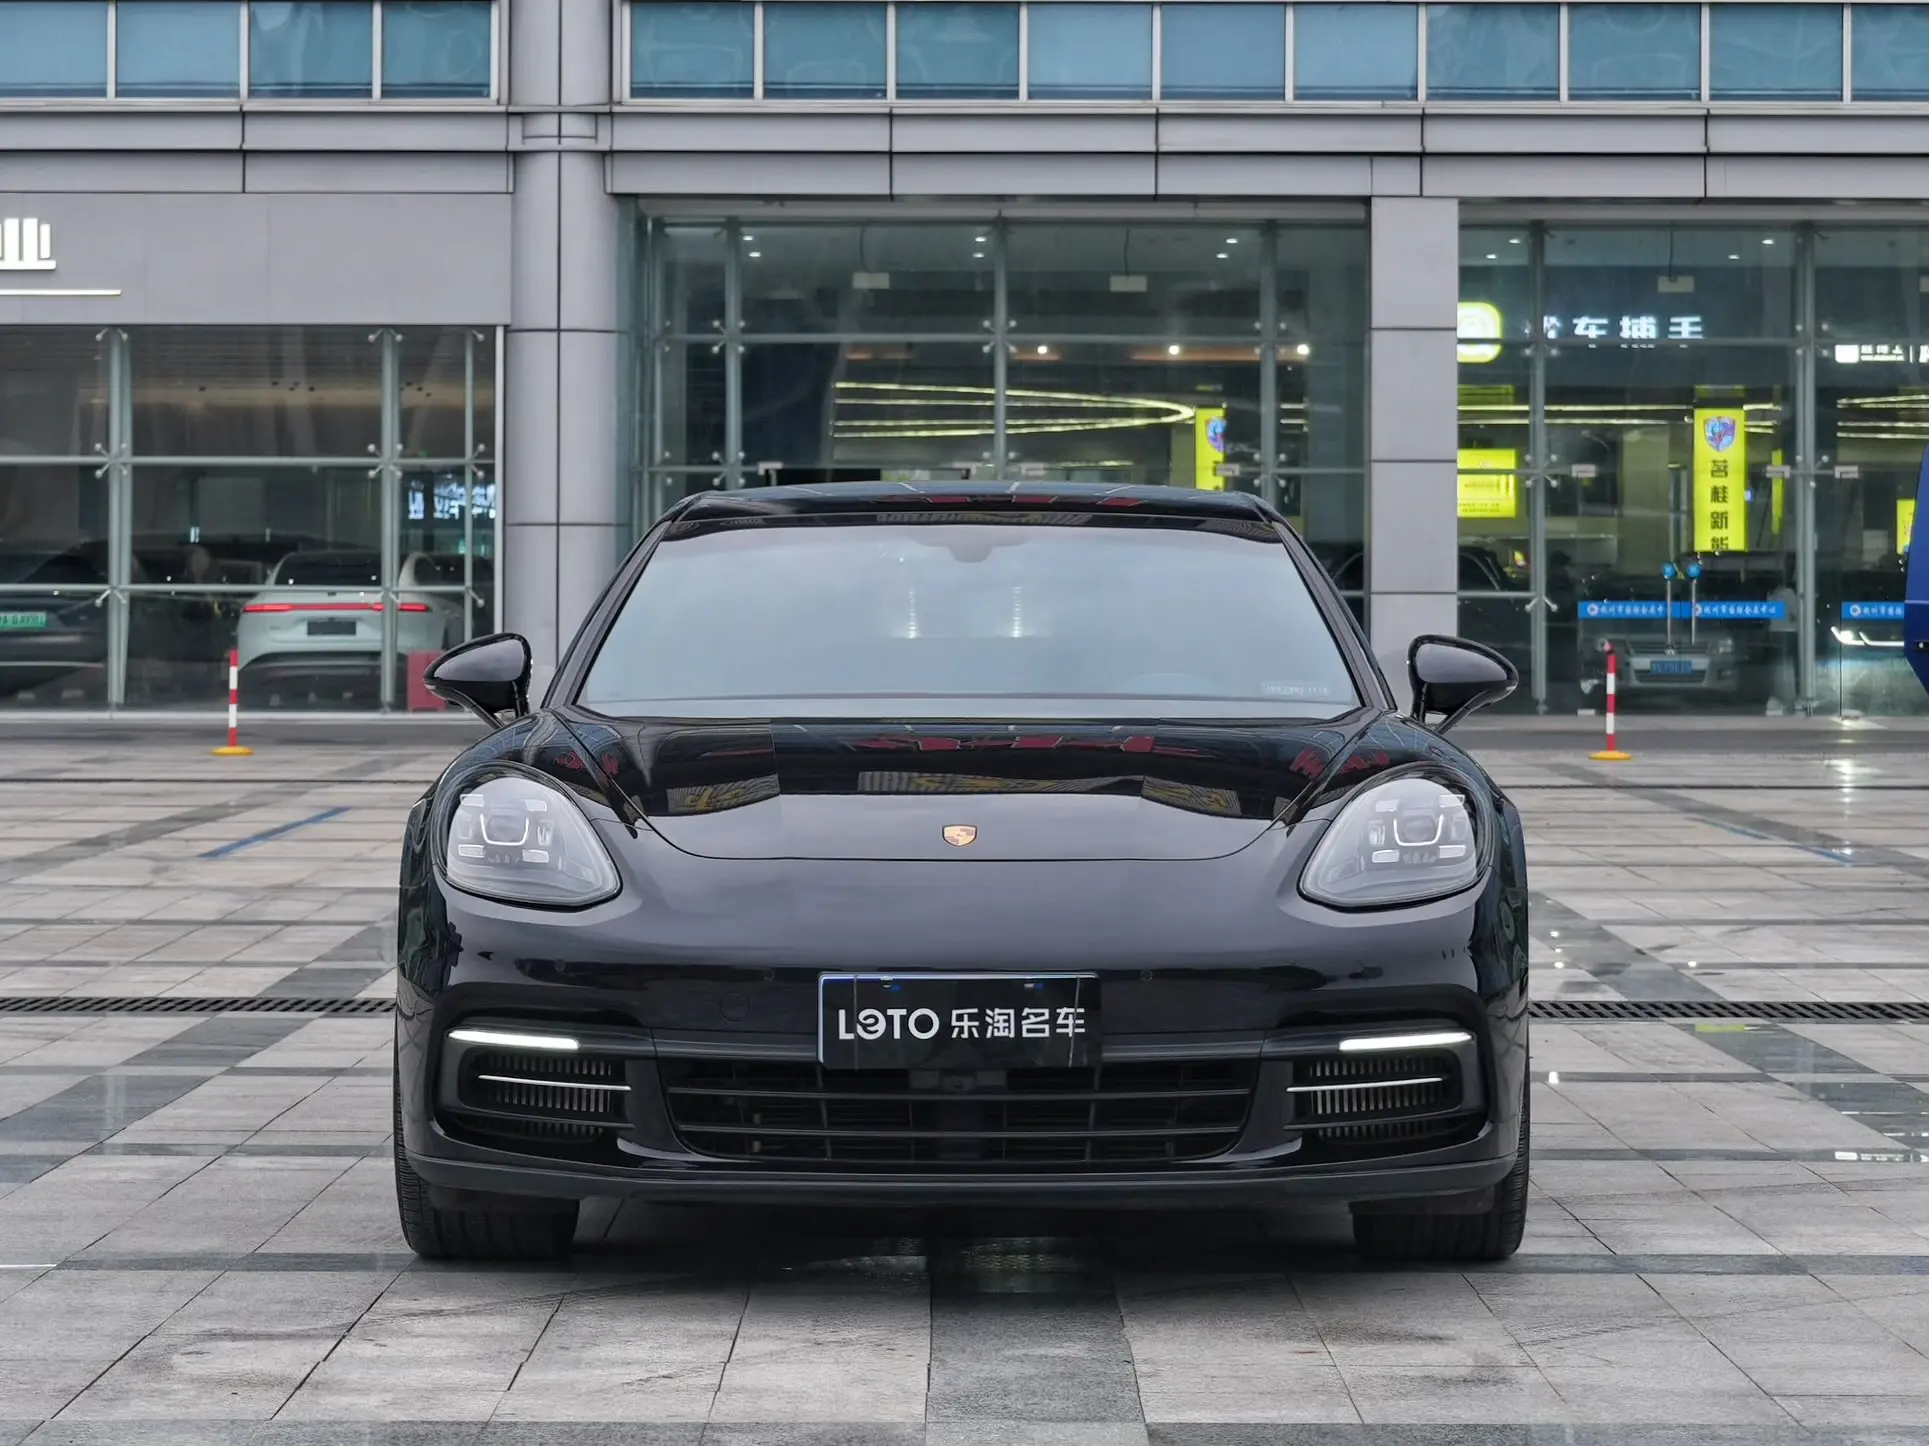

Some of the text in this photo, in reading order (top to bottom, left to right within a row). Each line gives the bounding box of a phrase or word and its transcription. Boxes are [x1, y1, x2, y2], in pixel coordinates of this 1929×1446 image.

[838, 1006, 1086, 1040] LOTO 乐淘名车
